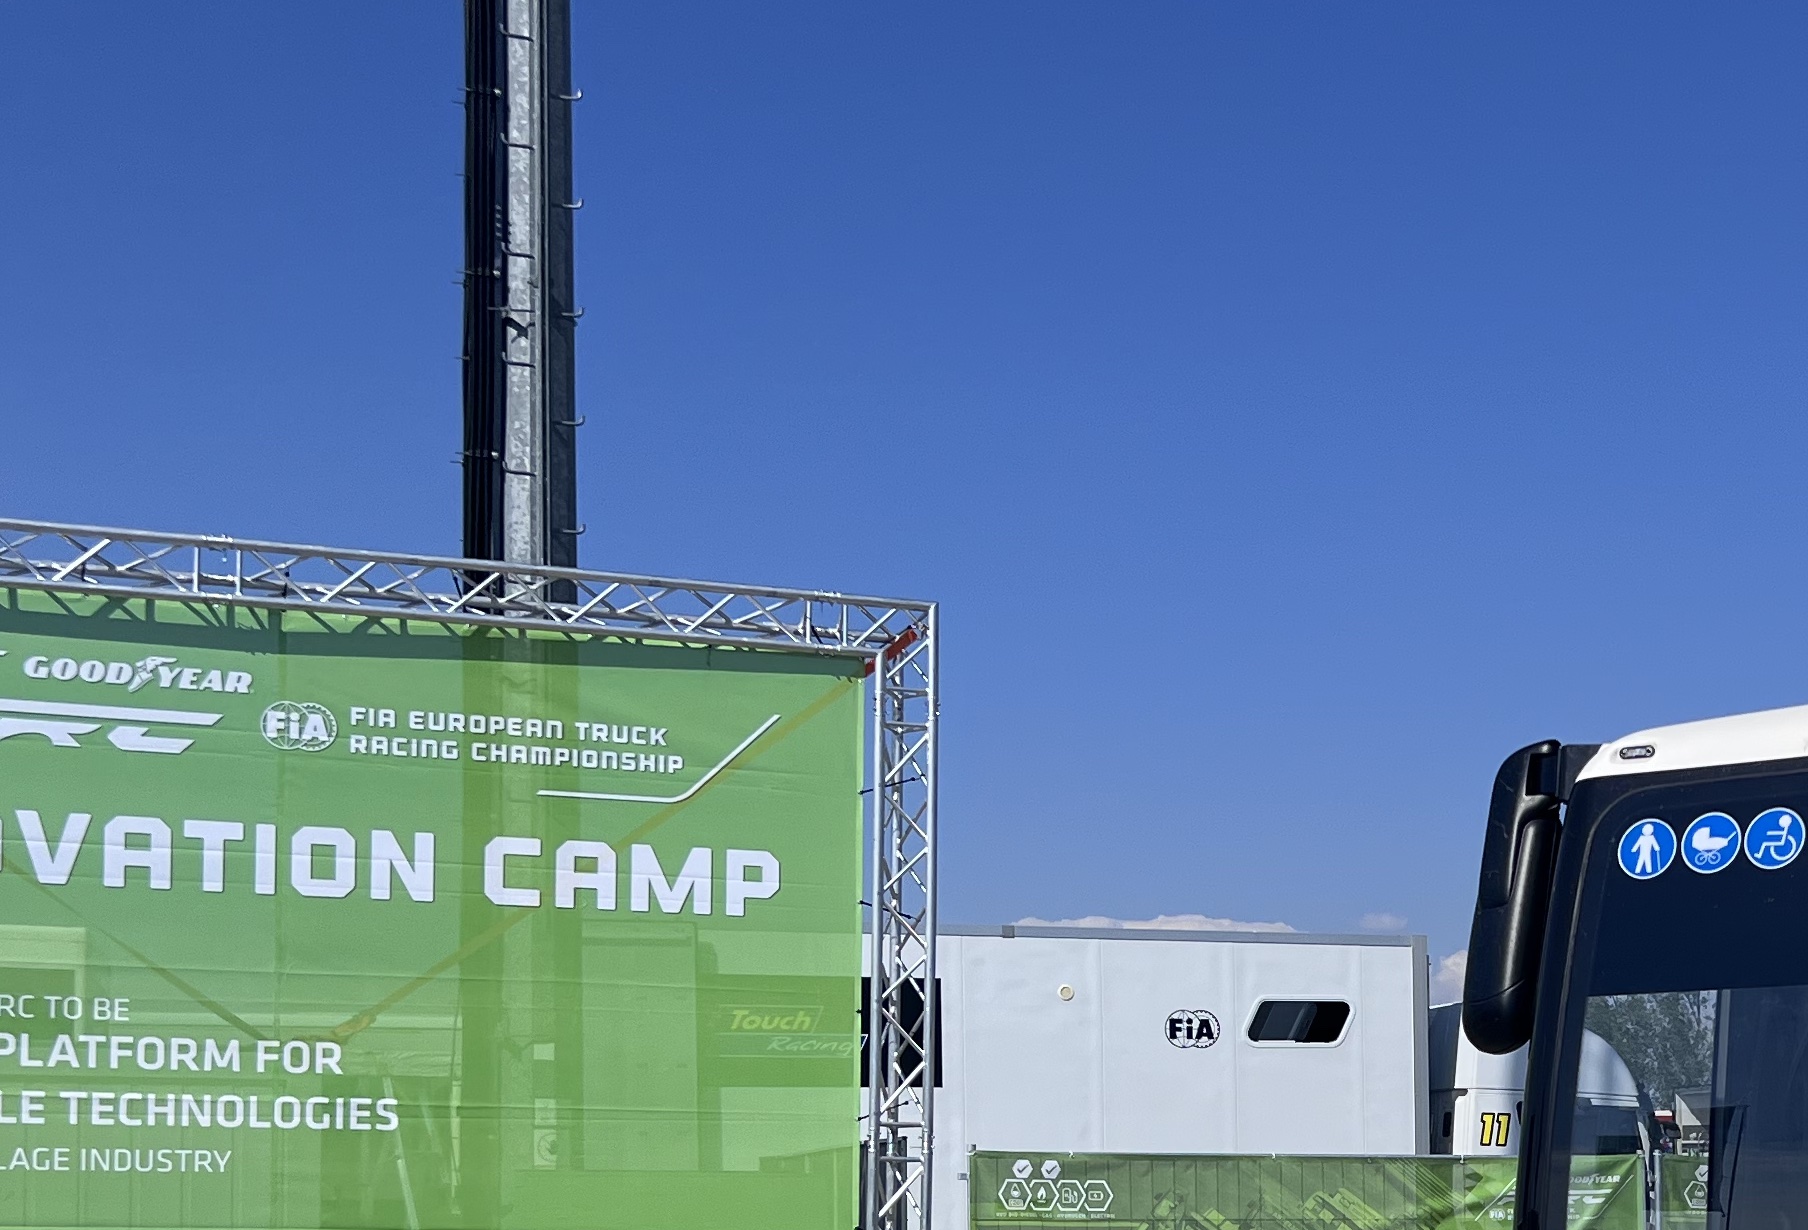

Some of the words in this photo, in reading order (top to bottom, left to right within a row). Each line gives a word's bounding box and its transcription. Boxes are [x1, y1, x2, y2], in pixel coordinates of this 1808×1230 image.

[23, 655, 253, 694] GOODYEAR
[350, 706, 396, 728] FIA
[408, 710, 563, 739] EUROPEAN
[574, 721, 668, 747] TRUCK
[349, 735, 459, 760] RACING
[471, 742, 685, 774] CHAMPIONSHIP
[0, 809, 436, 903] VATION
[483, 836, 781, 917] CAMP
[43, 996, 82, 1020] TO
[93, 998, 130, 1021] BE
[730, 1009, 812, 1032] Touch
[256, 1040, 344, 1075] FOR
[59, 1091, 400, 1132] TECHNOLOGIES
[1480, 1112, 1511, 1148] 11
[80, 1148, 232, 1174] INDUSTRY
